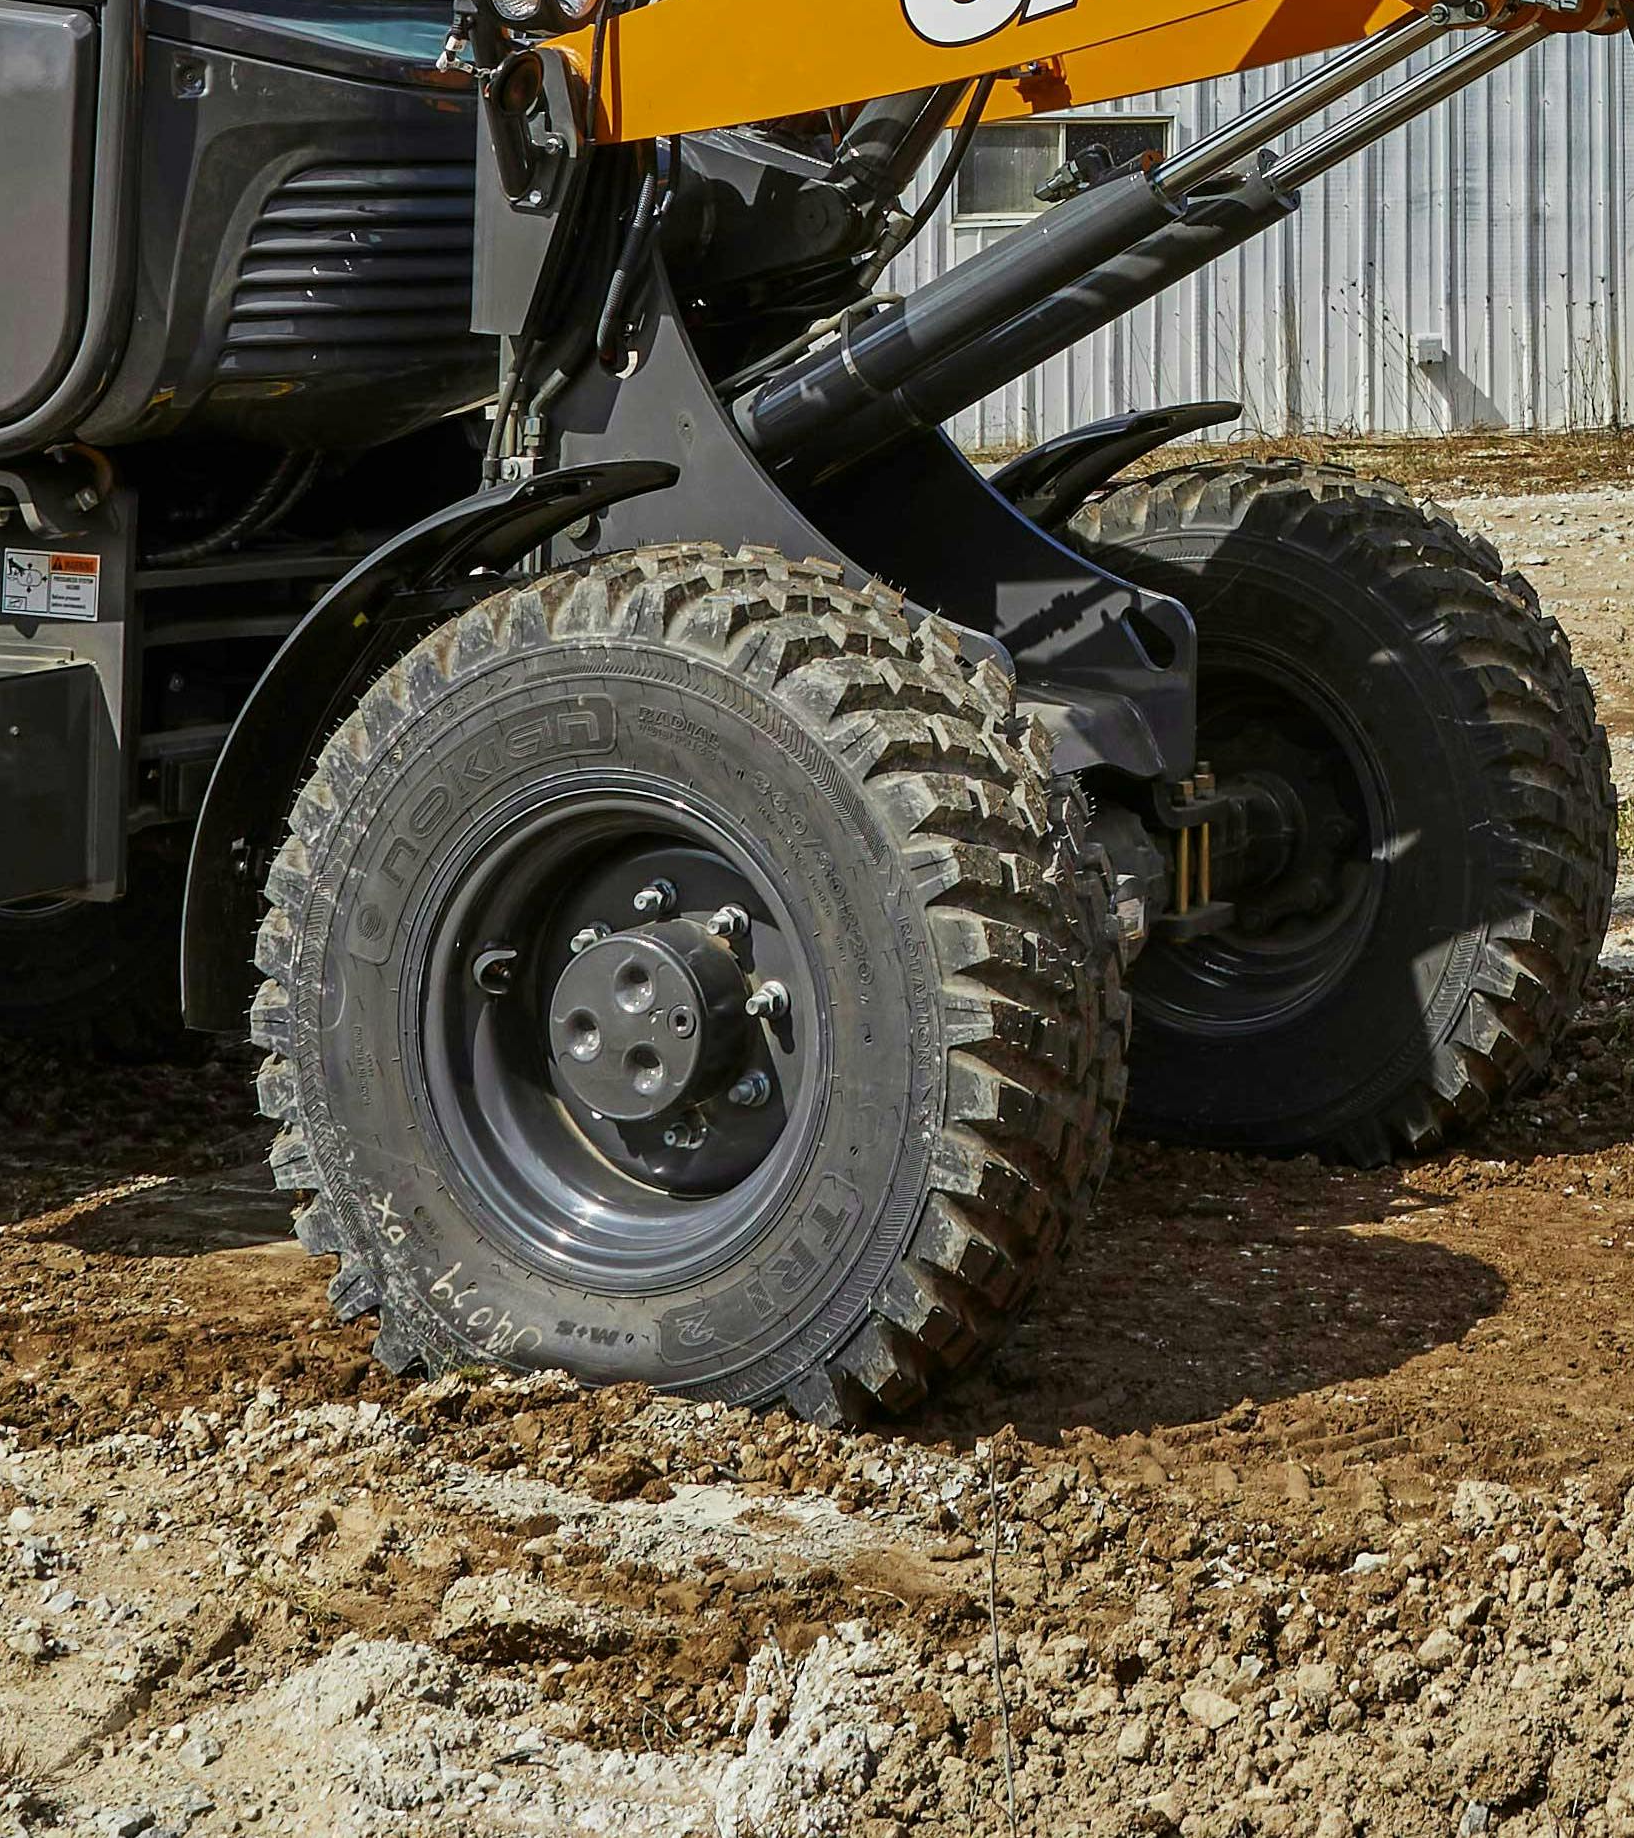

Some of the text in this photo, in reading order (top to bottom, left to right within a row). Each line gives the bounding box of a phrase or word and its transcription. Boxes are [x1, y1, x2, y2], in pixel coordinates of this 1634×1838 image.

[896, 914, 932, 1071] ROTATION
[675, 1201, 852, 1347] TRI 2
